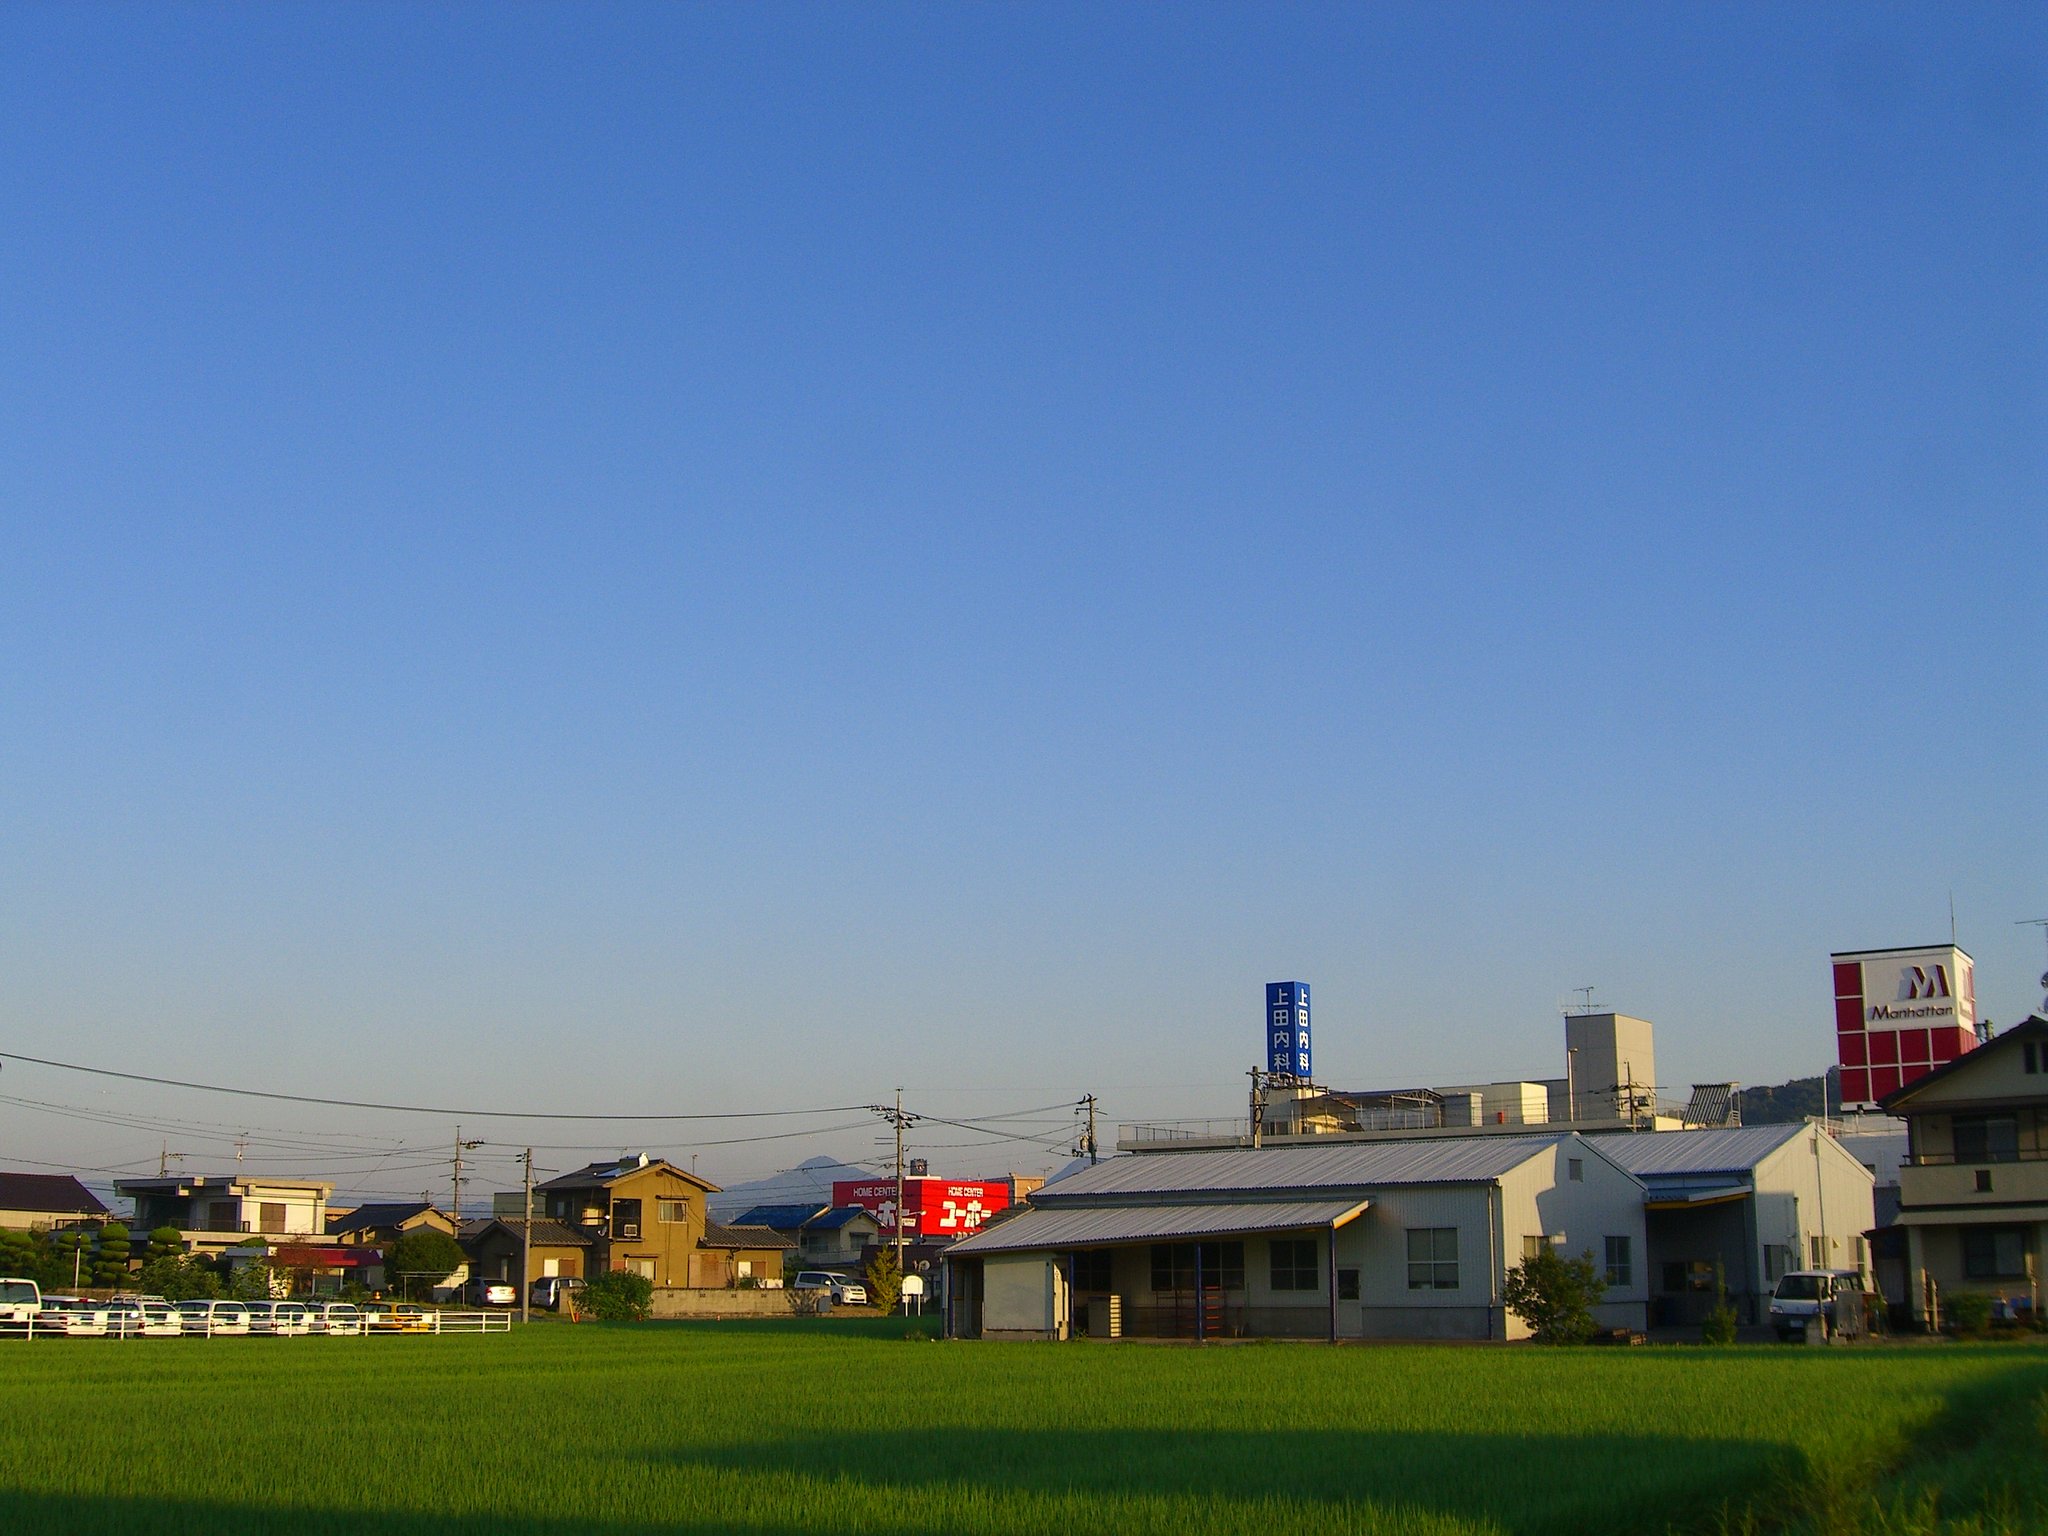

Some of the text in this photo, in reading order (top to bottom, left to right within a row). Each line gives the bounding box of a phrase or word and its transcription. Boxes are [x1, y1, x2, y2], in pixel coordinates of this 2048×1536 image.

[1872, 1005, 1953, 1020] Manhattan
[1273, 988, 1290, 1070] 上田内科
[1298, 988, 1309, 1071] 上田内科
[853, 1186, 898, 1197] HOME CENTE
[948, 1186, 983, 1197] HOME CENTER
